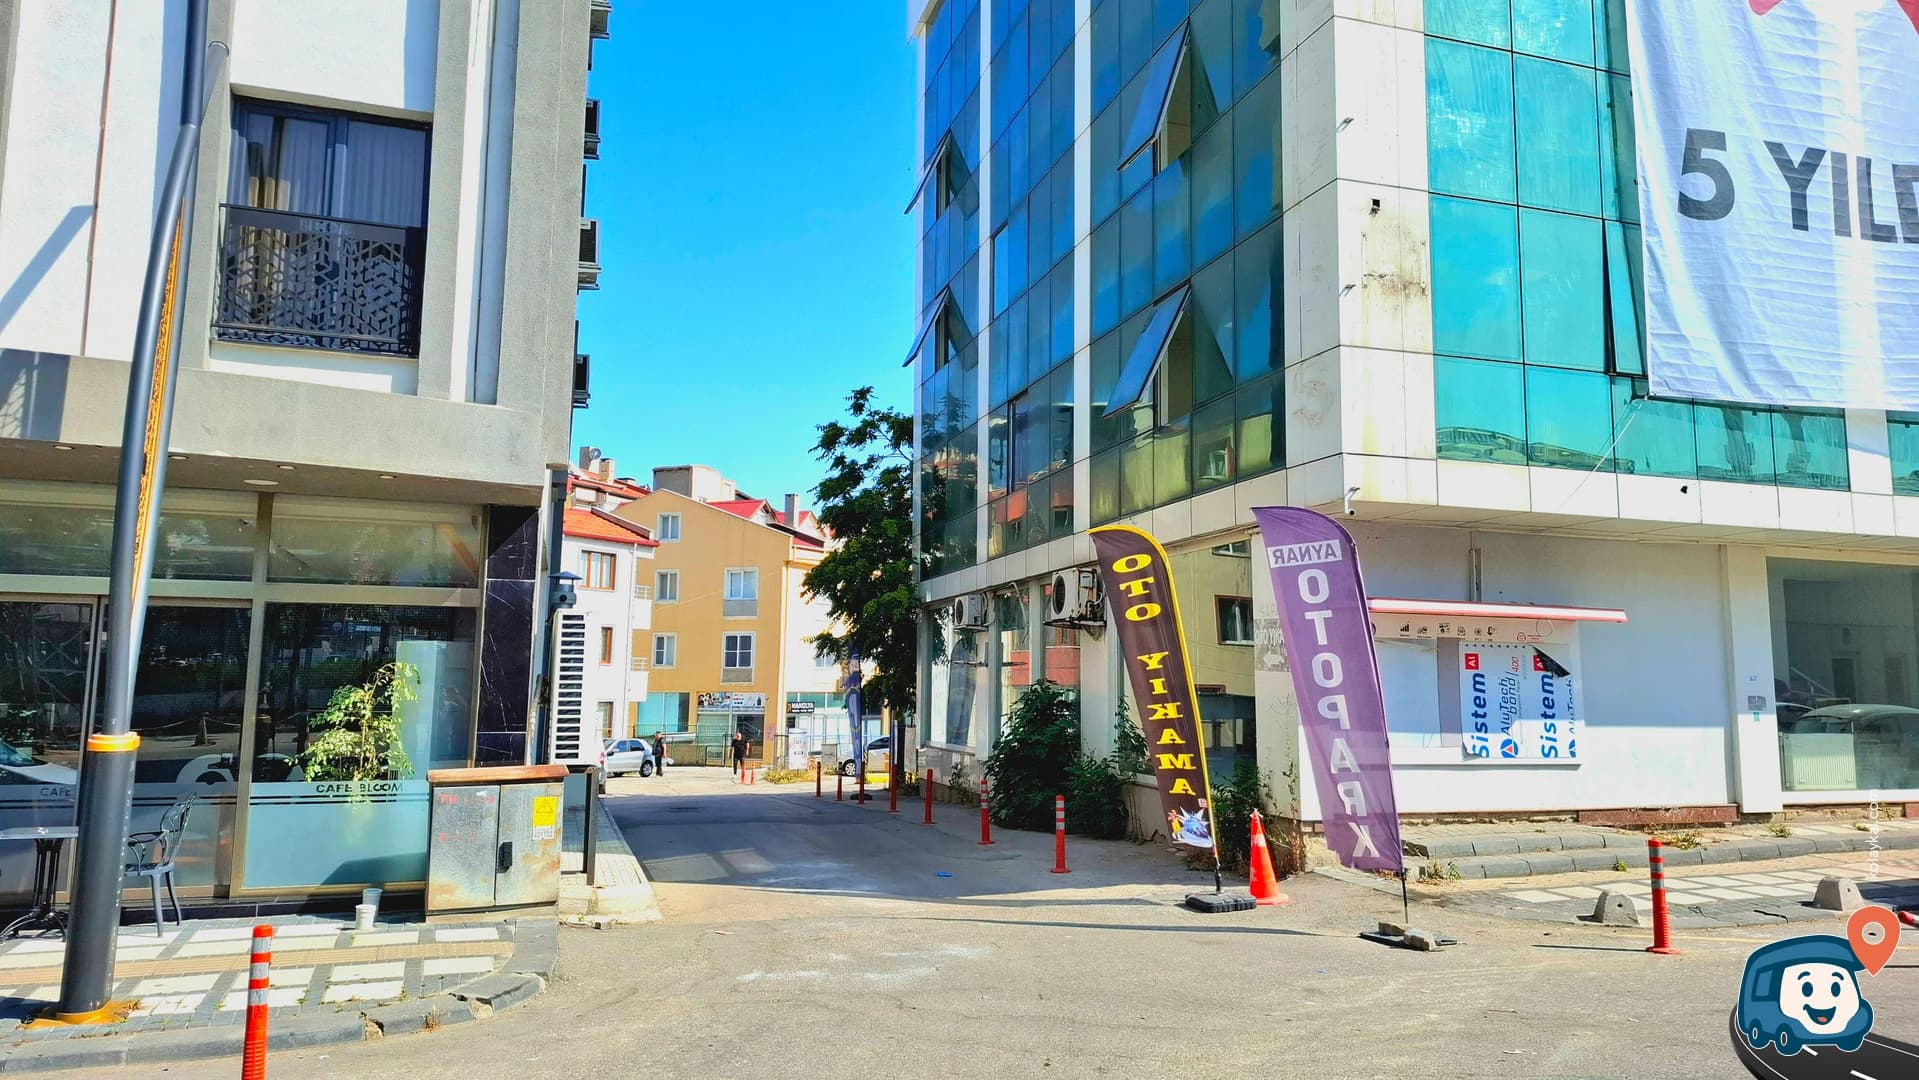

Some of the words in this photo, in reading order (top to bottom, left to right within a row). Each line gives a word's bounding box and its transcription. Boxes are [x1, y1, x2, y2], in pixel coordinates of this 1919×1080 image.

[1678, 128, 1736, 221] 5
[1511, 657, 1519, 672] 400
[1471, 673, 1490, 758] Sistem
[1540, 673, 1559, 758] Sistem
[315, 784, 352, 793] CAFE
[360, 783, 403, 792] BLOOM
